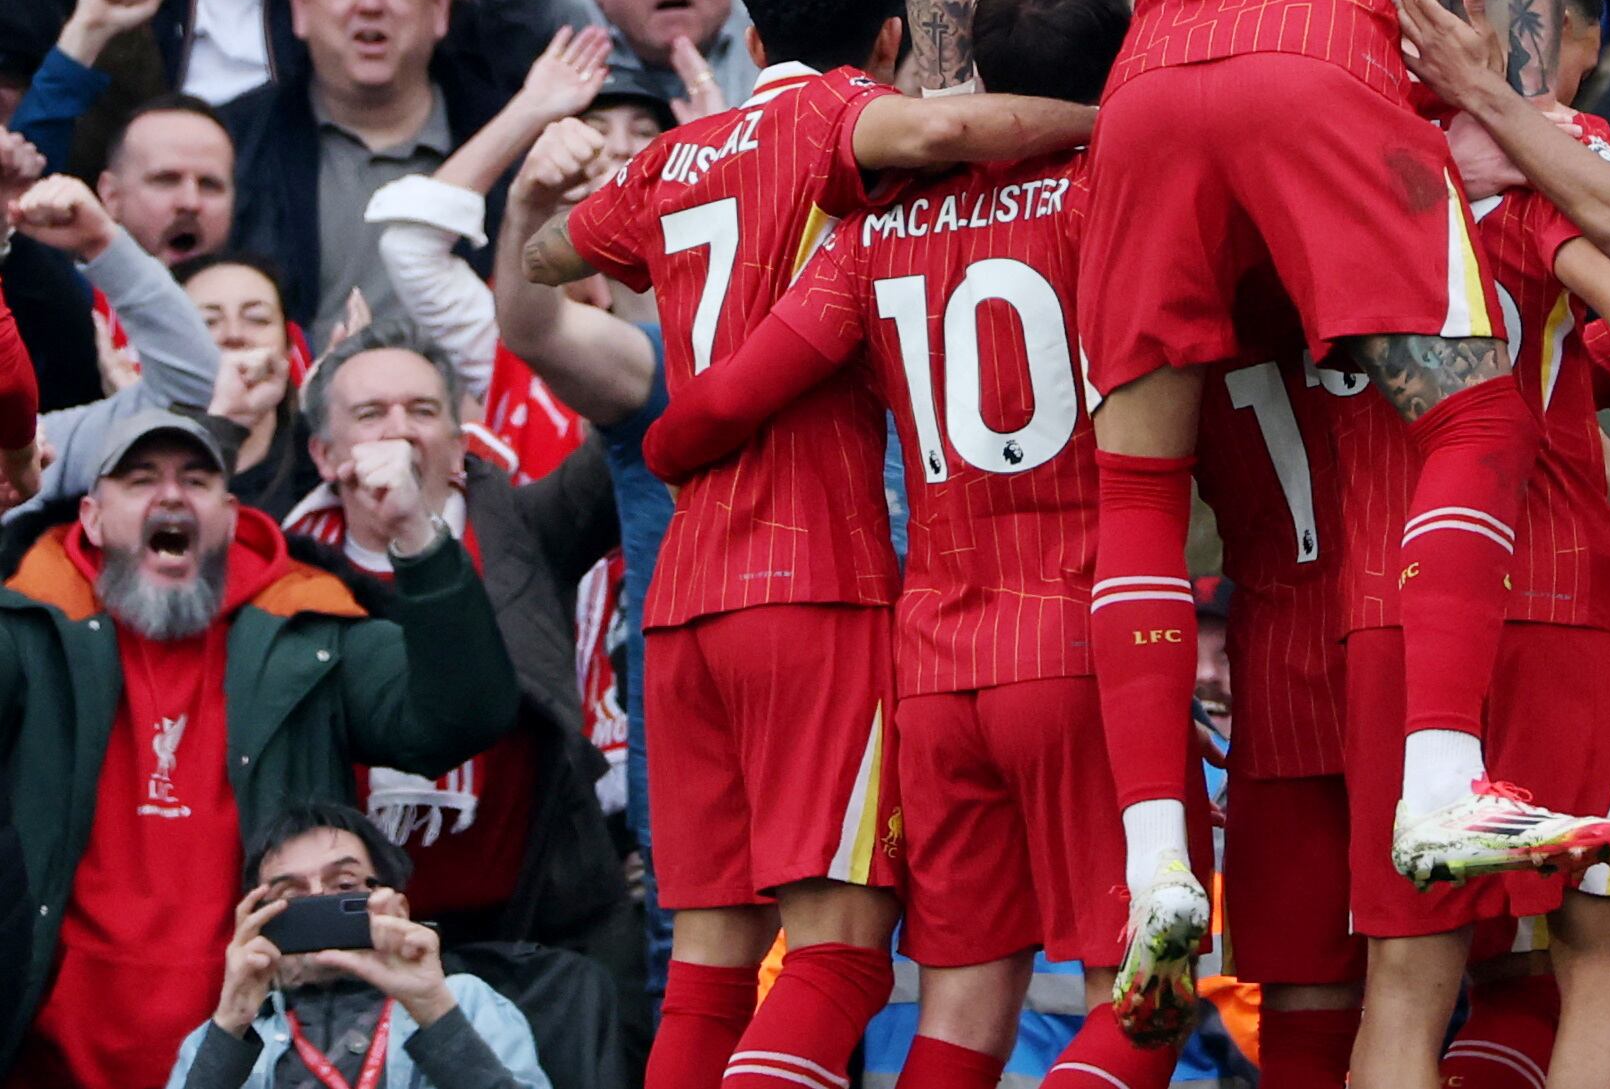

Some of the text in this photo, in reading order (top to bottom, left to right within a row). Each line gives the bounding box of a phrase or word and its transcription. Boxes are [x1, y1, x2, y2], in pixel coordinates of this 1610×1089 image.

[863, 198, 929, 247] MAC
[660, 197, 739, 376] 7
[873, 258, 1077, 483] 10
[1398, 562, 1419, 591] FC
[1133, 629, 1182, 645] LFC
